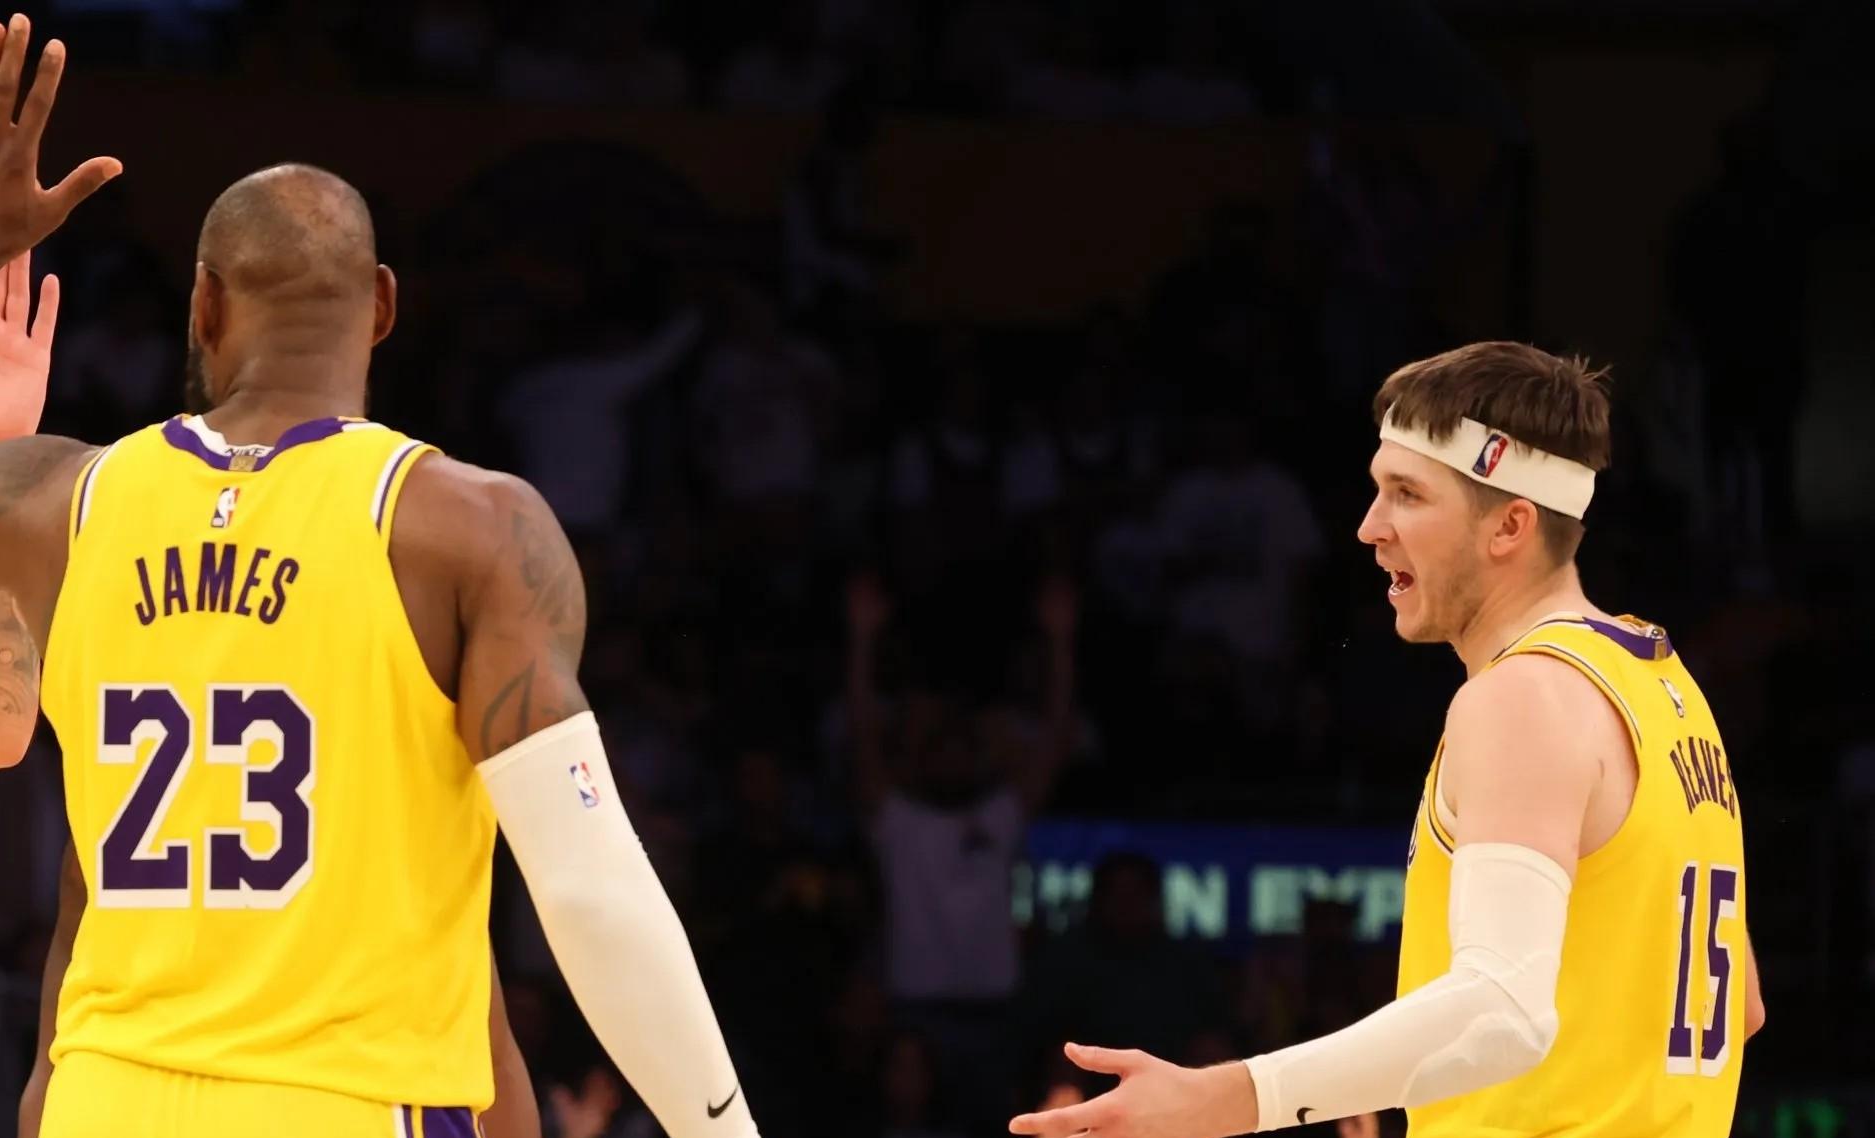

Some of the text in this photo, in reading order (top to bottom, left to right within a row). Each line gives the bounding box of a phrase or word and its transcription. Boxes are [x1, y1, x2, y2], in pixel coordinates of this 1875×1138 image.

[135, 542, 299, 626] JAMES
[96, 682, 316, 910] 23
[1666, 860, 1738, 1078] 15
